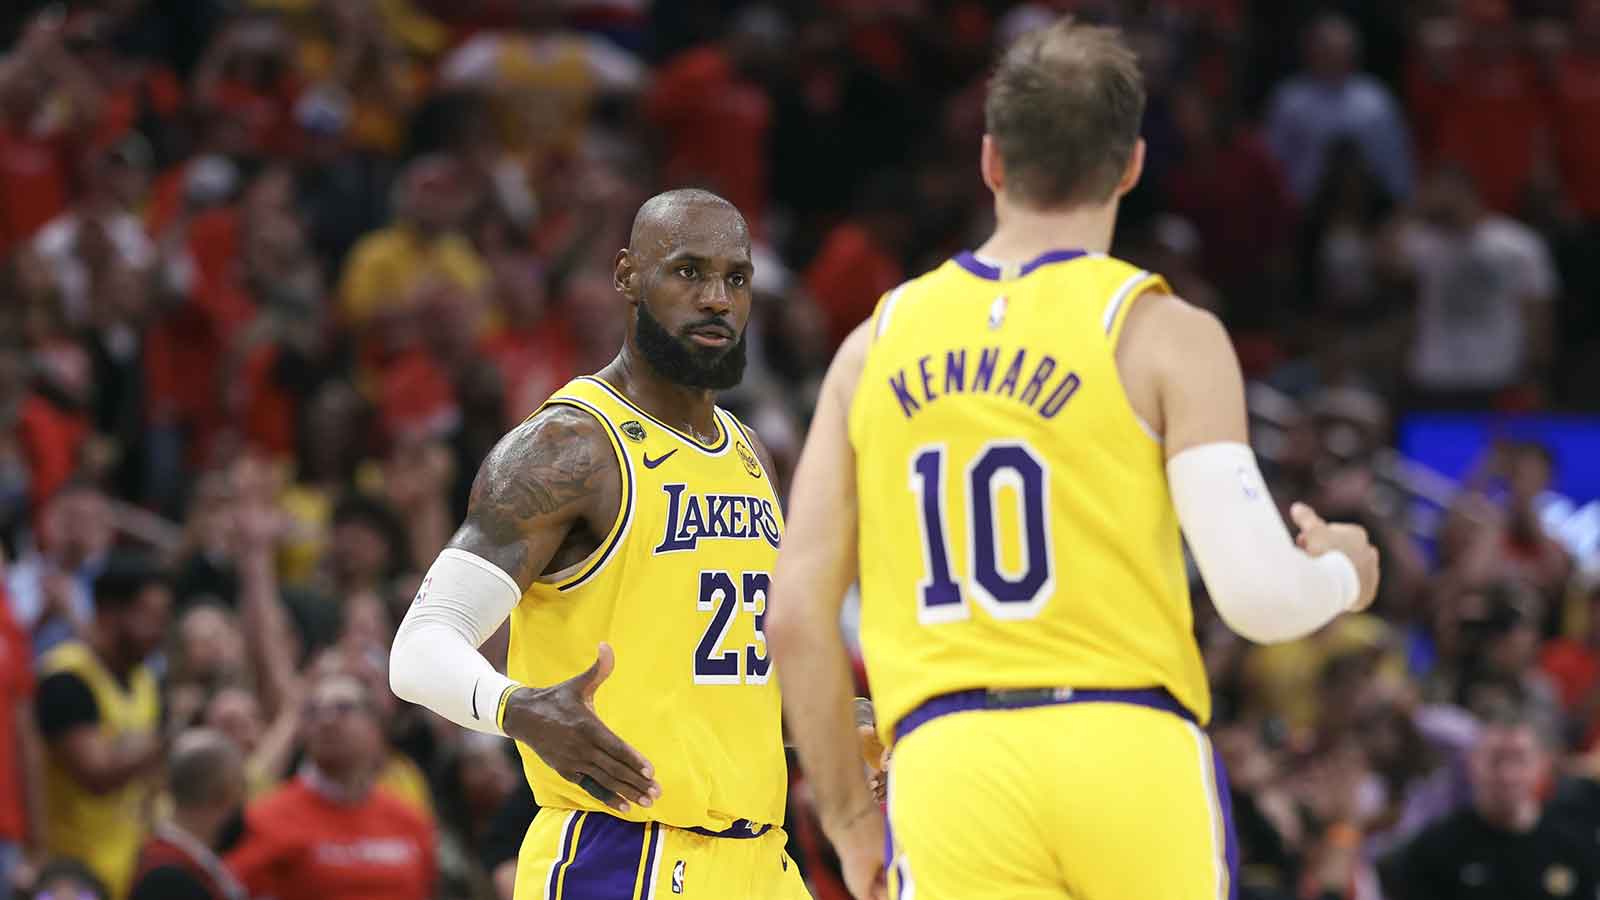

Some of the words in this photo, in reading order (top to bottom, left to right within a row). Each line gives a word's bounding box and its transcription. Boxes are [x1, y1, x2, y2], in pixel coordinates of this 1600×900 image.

[889, 347, 1081, 419] KENNARD
[654, 483, 781, 554] LAKERS
[911, 440, 1056, 623] 10
[694, 571, 774, 684] 23
